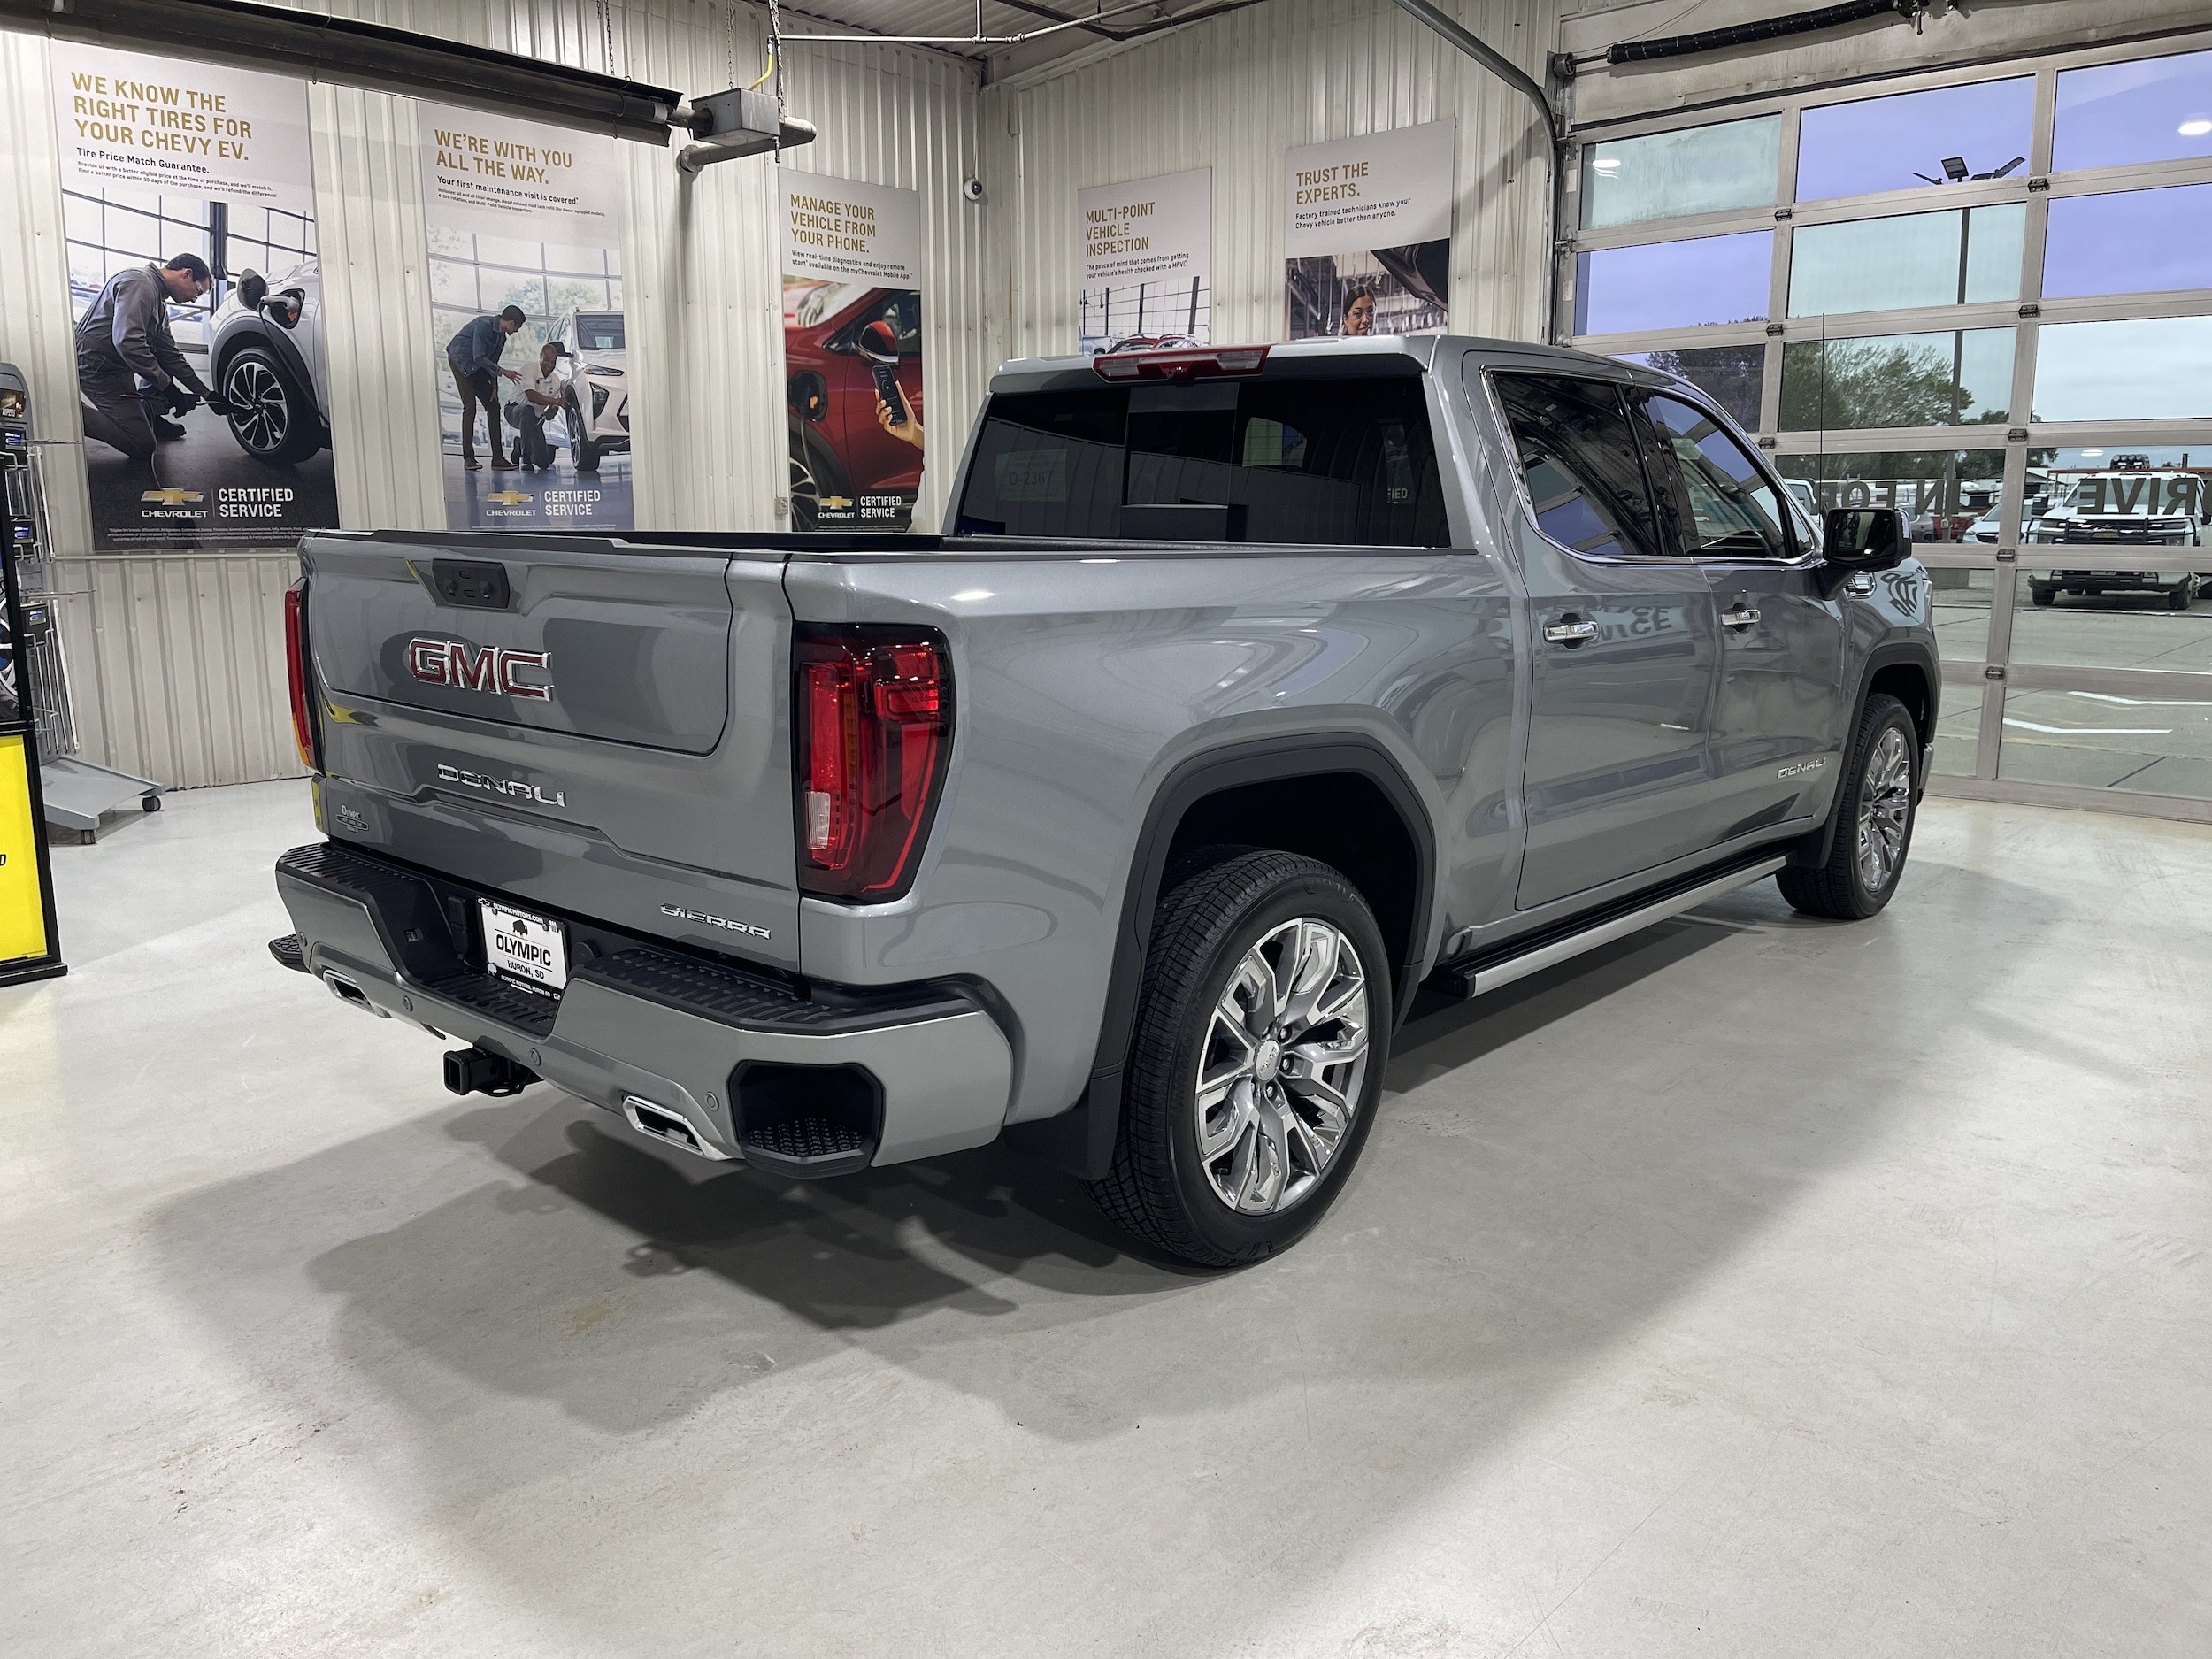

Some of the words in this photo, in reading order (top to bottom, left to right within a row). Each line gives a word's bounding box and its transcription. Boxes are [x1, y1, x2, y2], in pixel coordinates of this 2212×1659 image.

[71, 72, 107, 95] WE
[114, 79, 180, 106] KNOW
[186, 90, 227, 113] THE
[73, 96, 140, 122] RIGHT
[146, 107, 206, 132] TIRES
[213, 117, 252, 140] FOR
[74, 119, 134, 145] YOUR
[142, 129, 211, 156] CHEVY
[219, 140, 250, 161] EV.
[434, 129, 489, 155] WE'RE
[493, 140, 536, 163] WITH
[541, 149, 572, 168] YOU
[77, 147, 96, 157] Tire
[99, 150, 125, 162] Price
[127, 155, 156, 166] Match
[158, 159, 210, 173] Guarantee.
[435, 150, 469, 172] ALL
[472, 157, 506, 178] THE
[510, 164, 549, 185] WAY.
[1296, 166, 1339, 187] TRUST
[1342, 161, 1369, 180] THE
[437, 175, 455, 186] Your
[457, 179, 473, 189] first
[475, 184, 523, 197] maintenance
[524, 191, 540, 200] visit
[1296, 182, 1360, 205] EXPERTS.
[790, 193, 841, 216] MANAGE
[844, 204, 875, 221] YOUR
[1086, 201, 1156, 225] MULTI-POINT
[1295, 211, 1318, 220] Factory
[1319, 208, 1341, 218] trained
[1342, 204, 1377, 215] technicians
[1378, 200, 1395, 209] know
[1396, 197, 1411, 207] your
[790, 211, 841, 233] VEHICLE
[844, 220, 876, 237] FROM
[1086, 222, 1130, 241] VEHICLE
[1295, 221, 1313, 230] Chevy
[1314, 218, 1335, 227] vehicle
[1336, 215, 1356, 225] better
[1356, 213, 1371, 222] than
[1372, 210, 1396, 220] anyone.
[791, 228, 824, 247] YOUR
[827, 234, 870, 253] PHONE.
[1086, 236, 1149, 257] INSPECTION
[792, 250, 804, 258] View
[806, 251, 831, 263] real-time
[832, 256, 862, 267] diagnostics
[873, 262, 887, 271] enjoy
[809, 261, 832, 271] available
[850, 268, 882, 278] myChevrolet
[1095, 263, 1109, 272] peace
[1171, 252, 1189, 261] getting
[1097, 269, 1118, 278] vehicle's
[1009, 470, 1053, 486] D-2367
[218, 488, 294, 503] CERTIFIED
[544, 489, 601, 503] CERTIFIED
[860, 495, 902, 506] CERTIFIED
[141, 509, 208, 518] CHEVROLET
[219, 503, 283, 518] SERVICE
[545, 503, 593, 516] SERVICE
[860, 507, 895, 518] SERVICE
[408, 636, 555, 703] GMC
[1776, 756, 1827, 780] DENALI
[436, 763, 565, 808] DENALI
[660, 902, 772, 940] SIERRA
[496, 934, 551, 967] OLYMPIC
[507, 960, 534, 977] HURON,
[534, 969, 545, 979] SD
